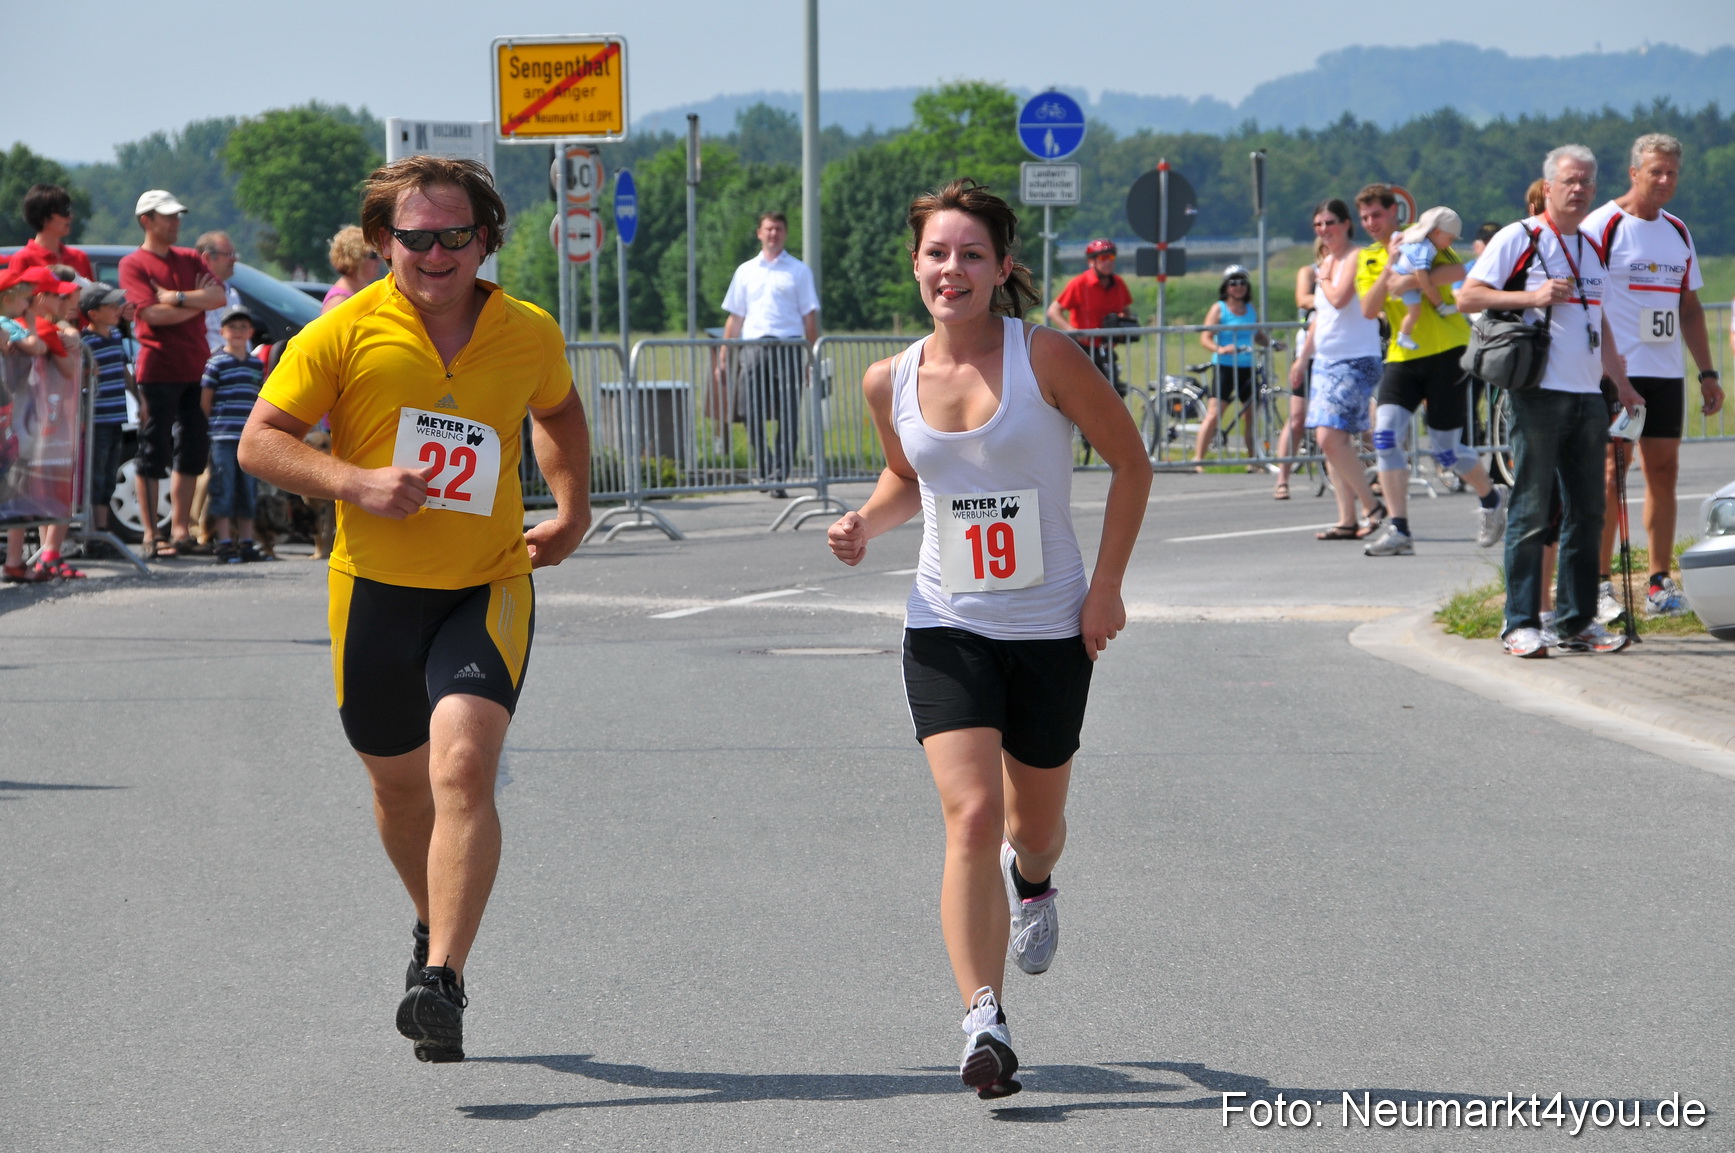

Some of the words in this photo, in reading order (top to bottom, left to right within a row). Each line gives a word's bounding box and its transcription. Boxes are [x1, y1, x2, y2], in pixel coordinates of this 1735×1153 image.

[509, 54, 610, 84] Sengenthal
[553, 86, 597, 102] Anger
[1652, 310, 1674, 337] 50
[416, 415, 464, 433] MEYER
[416, 426, 464, 441] WERBUNG
[418, 441, 477, 502] 22
[952, 498, 997, 511] MEYER
[952, 509, 999, 520] WERBUNG
[965, 522, 1017, 580] 19
[453, 671, 486, 679] adidas
